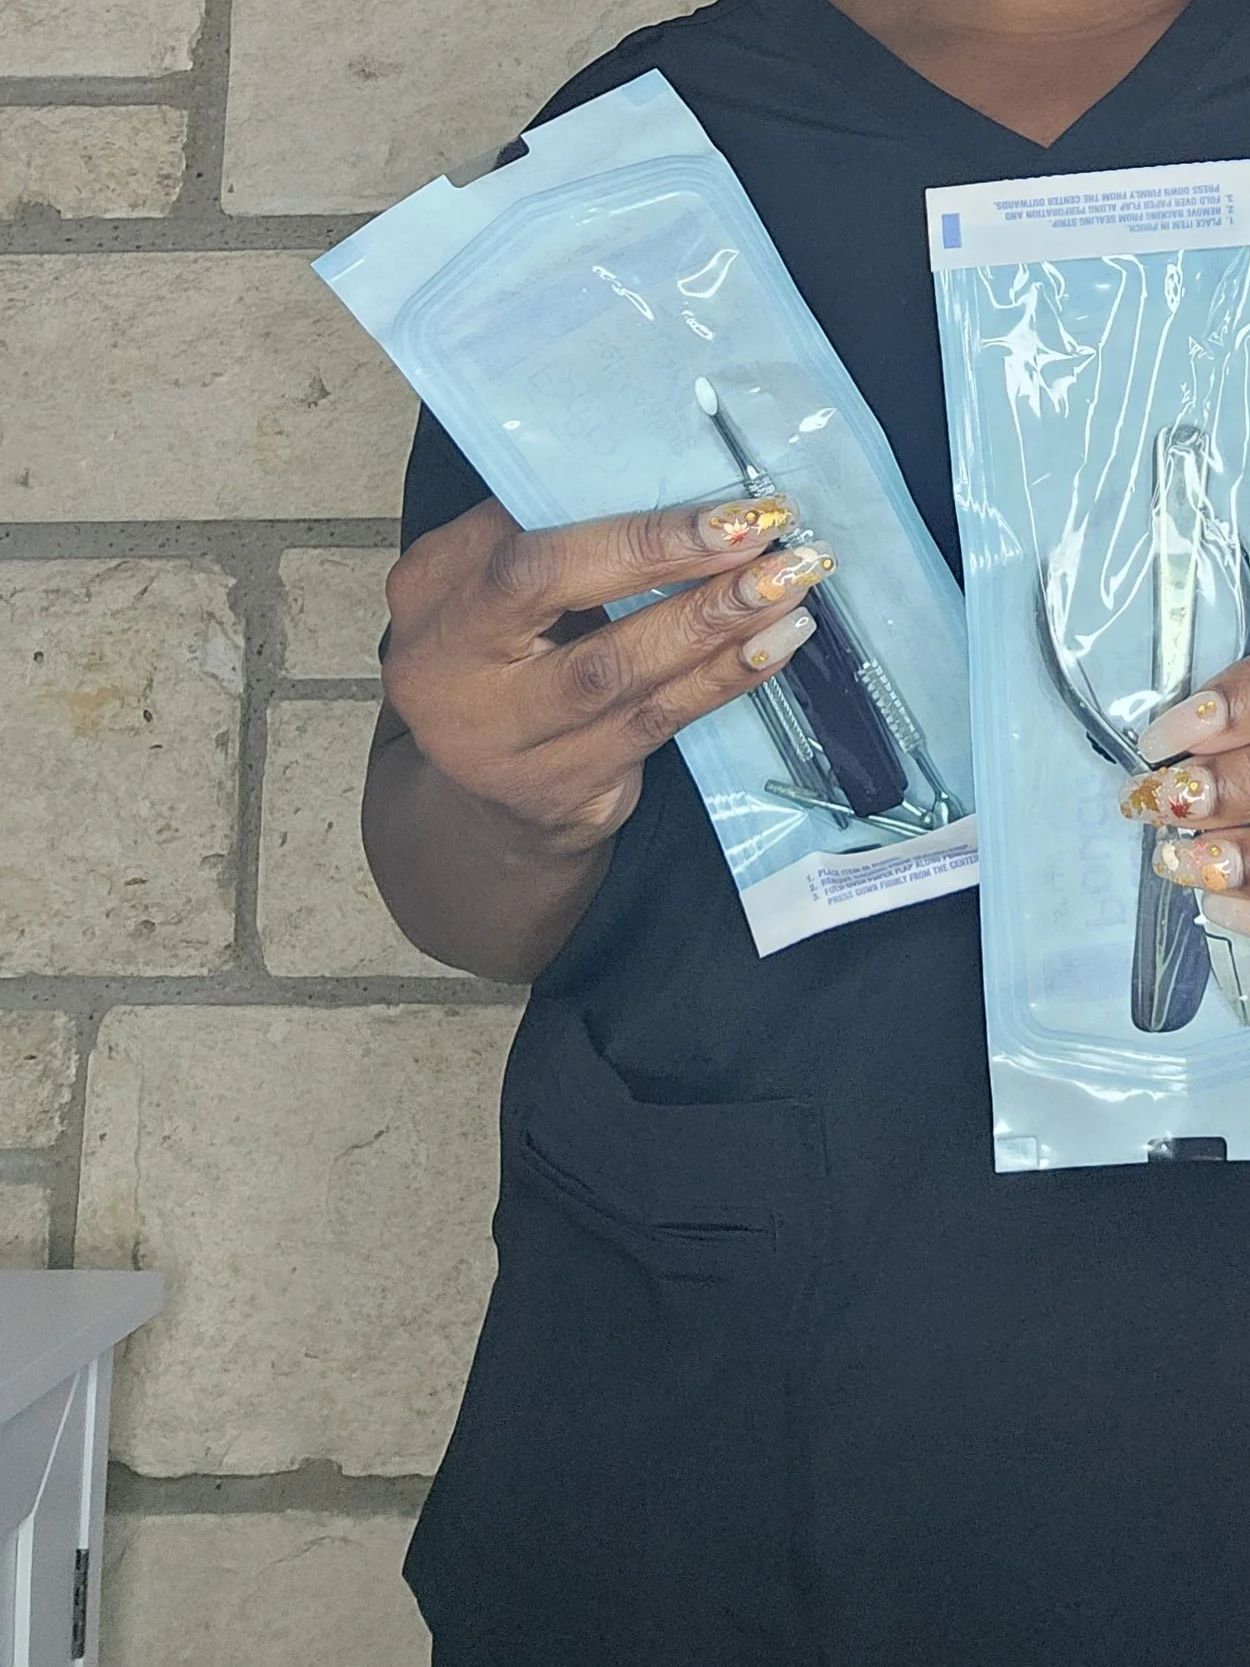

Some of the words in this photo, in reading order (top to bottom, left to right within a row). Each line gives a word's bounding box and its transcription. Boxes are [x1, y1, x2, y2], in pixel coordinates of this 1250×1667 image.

[1130, 188, 1161, 199] FIRMLY
[1164, 186, 1189, 196] DOWN
[1192, 184, 1220, 193] PRESS
[1048, 195, 1080, 206] CENTER
[1083, 194, 1099, 202] THE
[1102, 191, 1126, 201] FROM
[1200, 195, 1220, 205] FOLD
[993, 198, 1044, 210] OUTWARDS.
[1120, 202, 1140, 211] FLAP
[1144, 199, 1172, 209] PAPER
[1175, 197, 1196, 207] OVER
[1026, 206, 1085, 219] PERFORATION
[1088, 203, 1117, 214] ALONG
[1186, 207, 1221, 217] REMOVE
[1226, 206, 1234, 214] 2.
[1005, 211, 1023, 220] AND
[1079, 215, 1116, 226] SEALING
[1119, 213, 1143, 222] FROM
[1049, 218, 1077, 228] STRIP.
[1161, 222, 1169, 230] IN
[1173, 220, 1192, 230] ITEM
[1196, 218, 1221, 227] PLACE
[910, 869, 931, 882] FROM
[933, 865, 948, 875] THE
